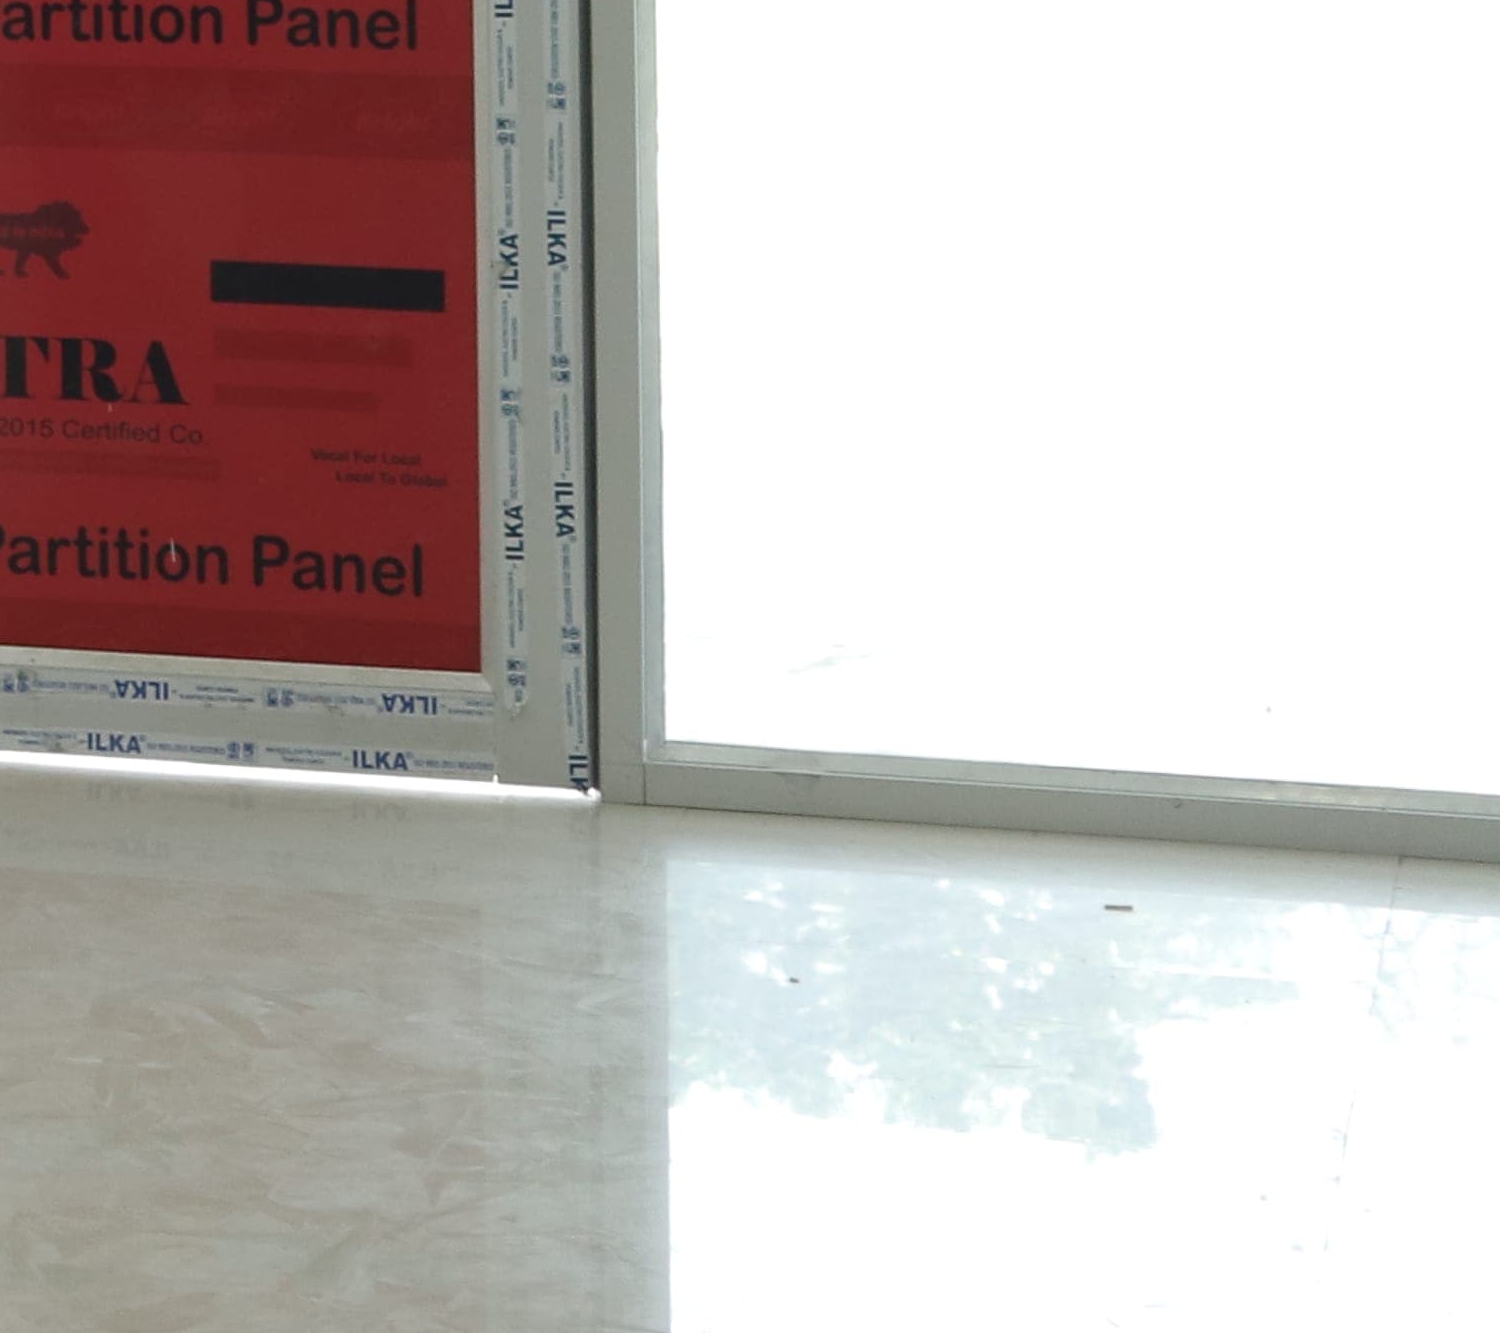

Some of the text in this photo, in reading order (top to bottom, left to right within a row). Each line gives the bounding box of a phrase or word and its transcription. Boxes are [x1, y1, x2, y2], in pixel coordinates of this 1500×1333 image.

[547, 211, 566, 265] ILKA
[61, 419, 160, 444] Certified
[554, 482, 574, 537] ILKA
[505, 506, 524, 560] ILKA
[252, 534, 424, 598] Panel
[115, 680, 168, 700] ILKA
[382, 694, 437, 715] ILKA
[87, 733, 140, 753] ILKA
[353, 750, 407, 770] ILKA
